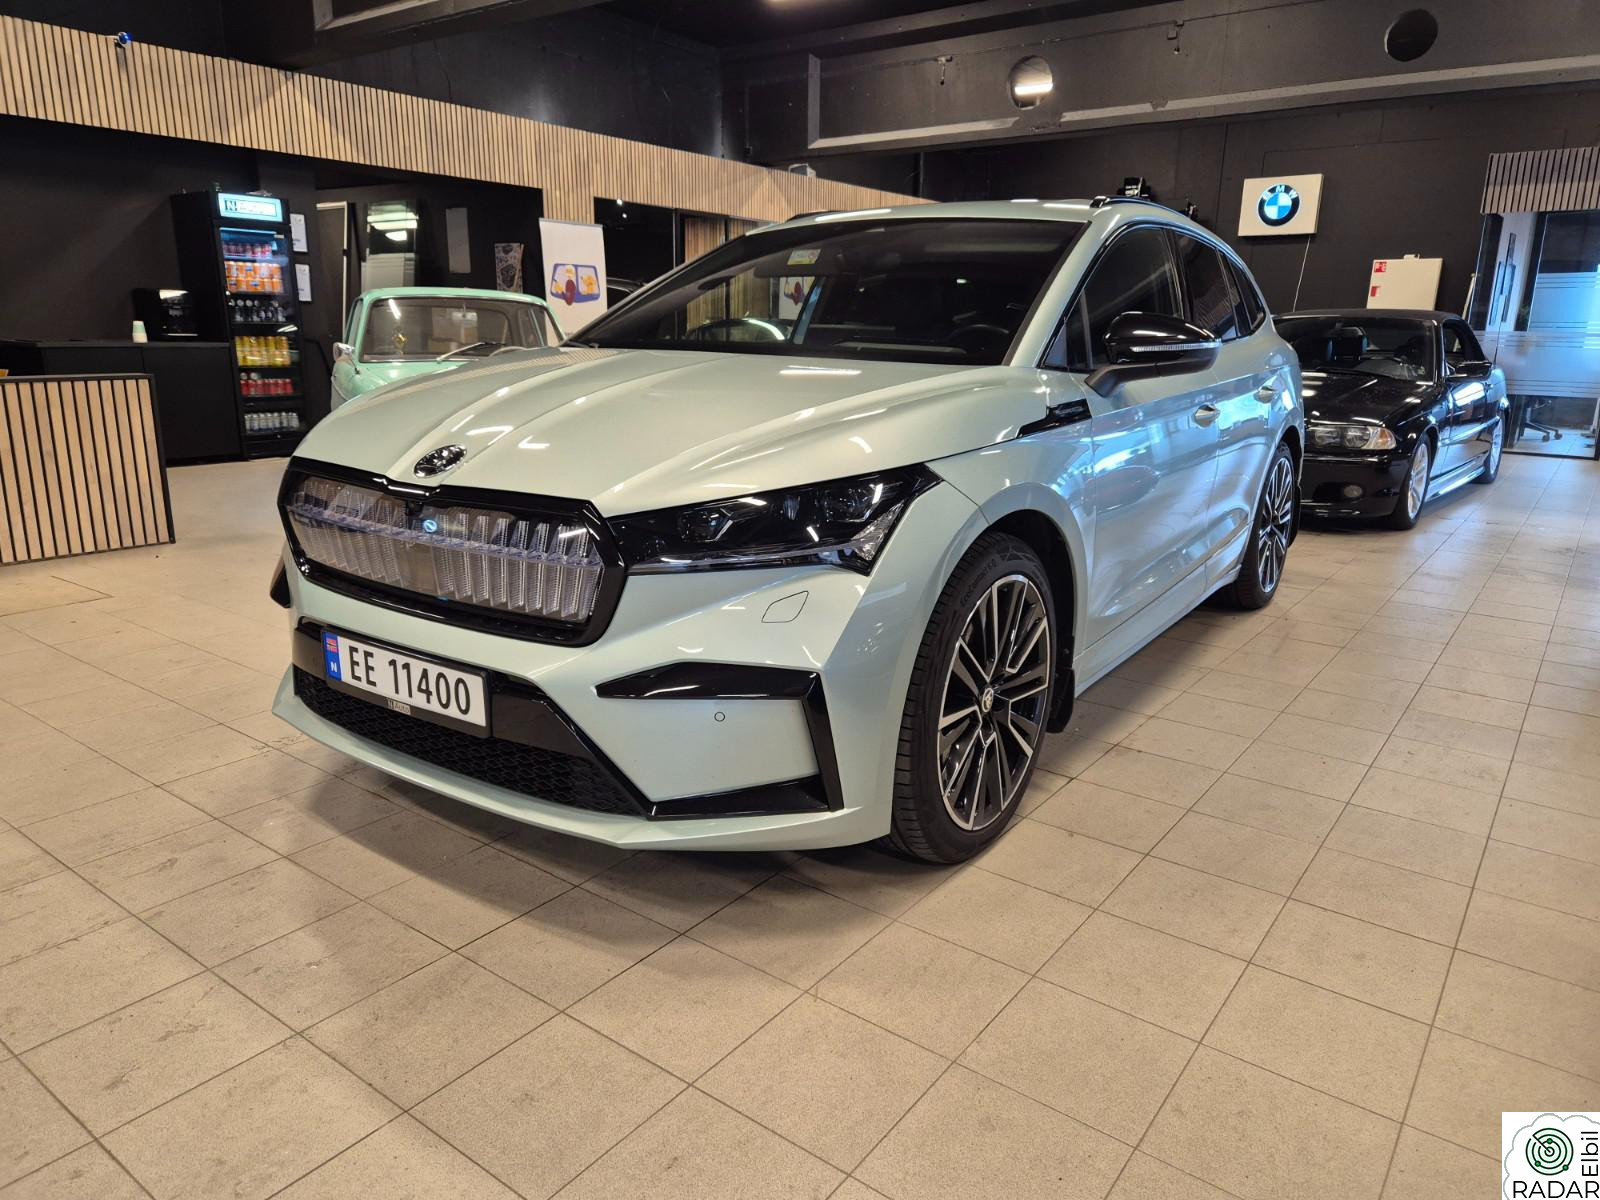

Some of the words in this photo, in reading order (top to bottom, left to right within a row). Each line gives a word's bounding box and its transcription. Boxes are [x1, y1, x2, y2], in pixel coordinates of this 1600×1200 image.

[1262, 184, 1298, 200] BMW
[330, 661, 338, 673] N
[348, 645, 377, 687] EE
[388, 658, 471, 715] 11400
